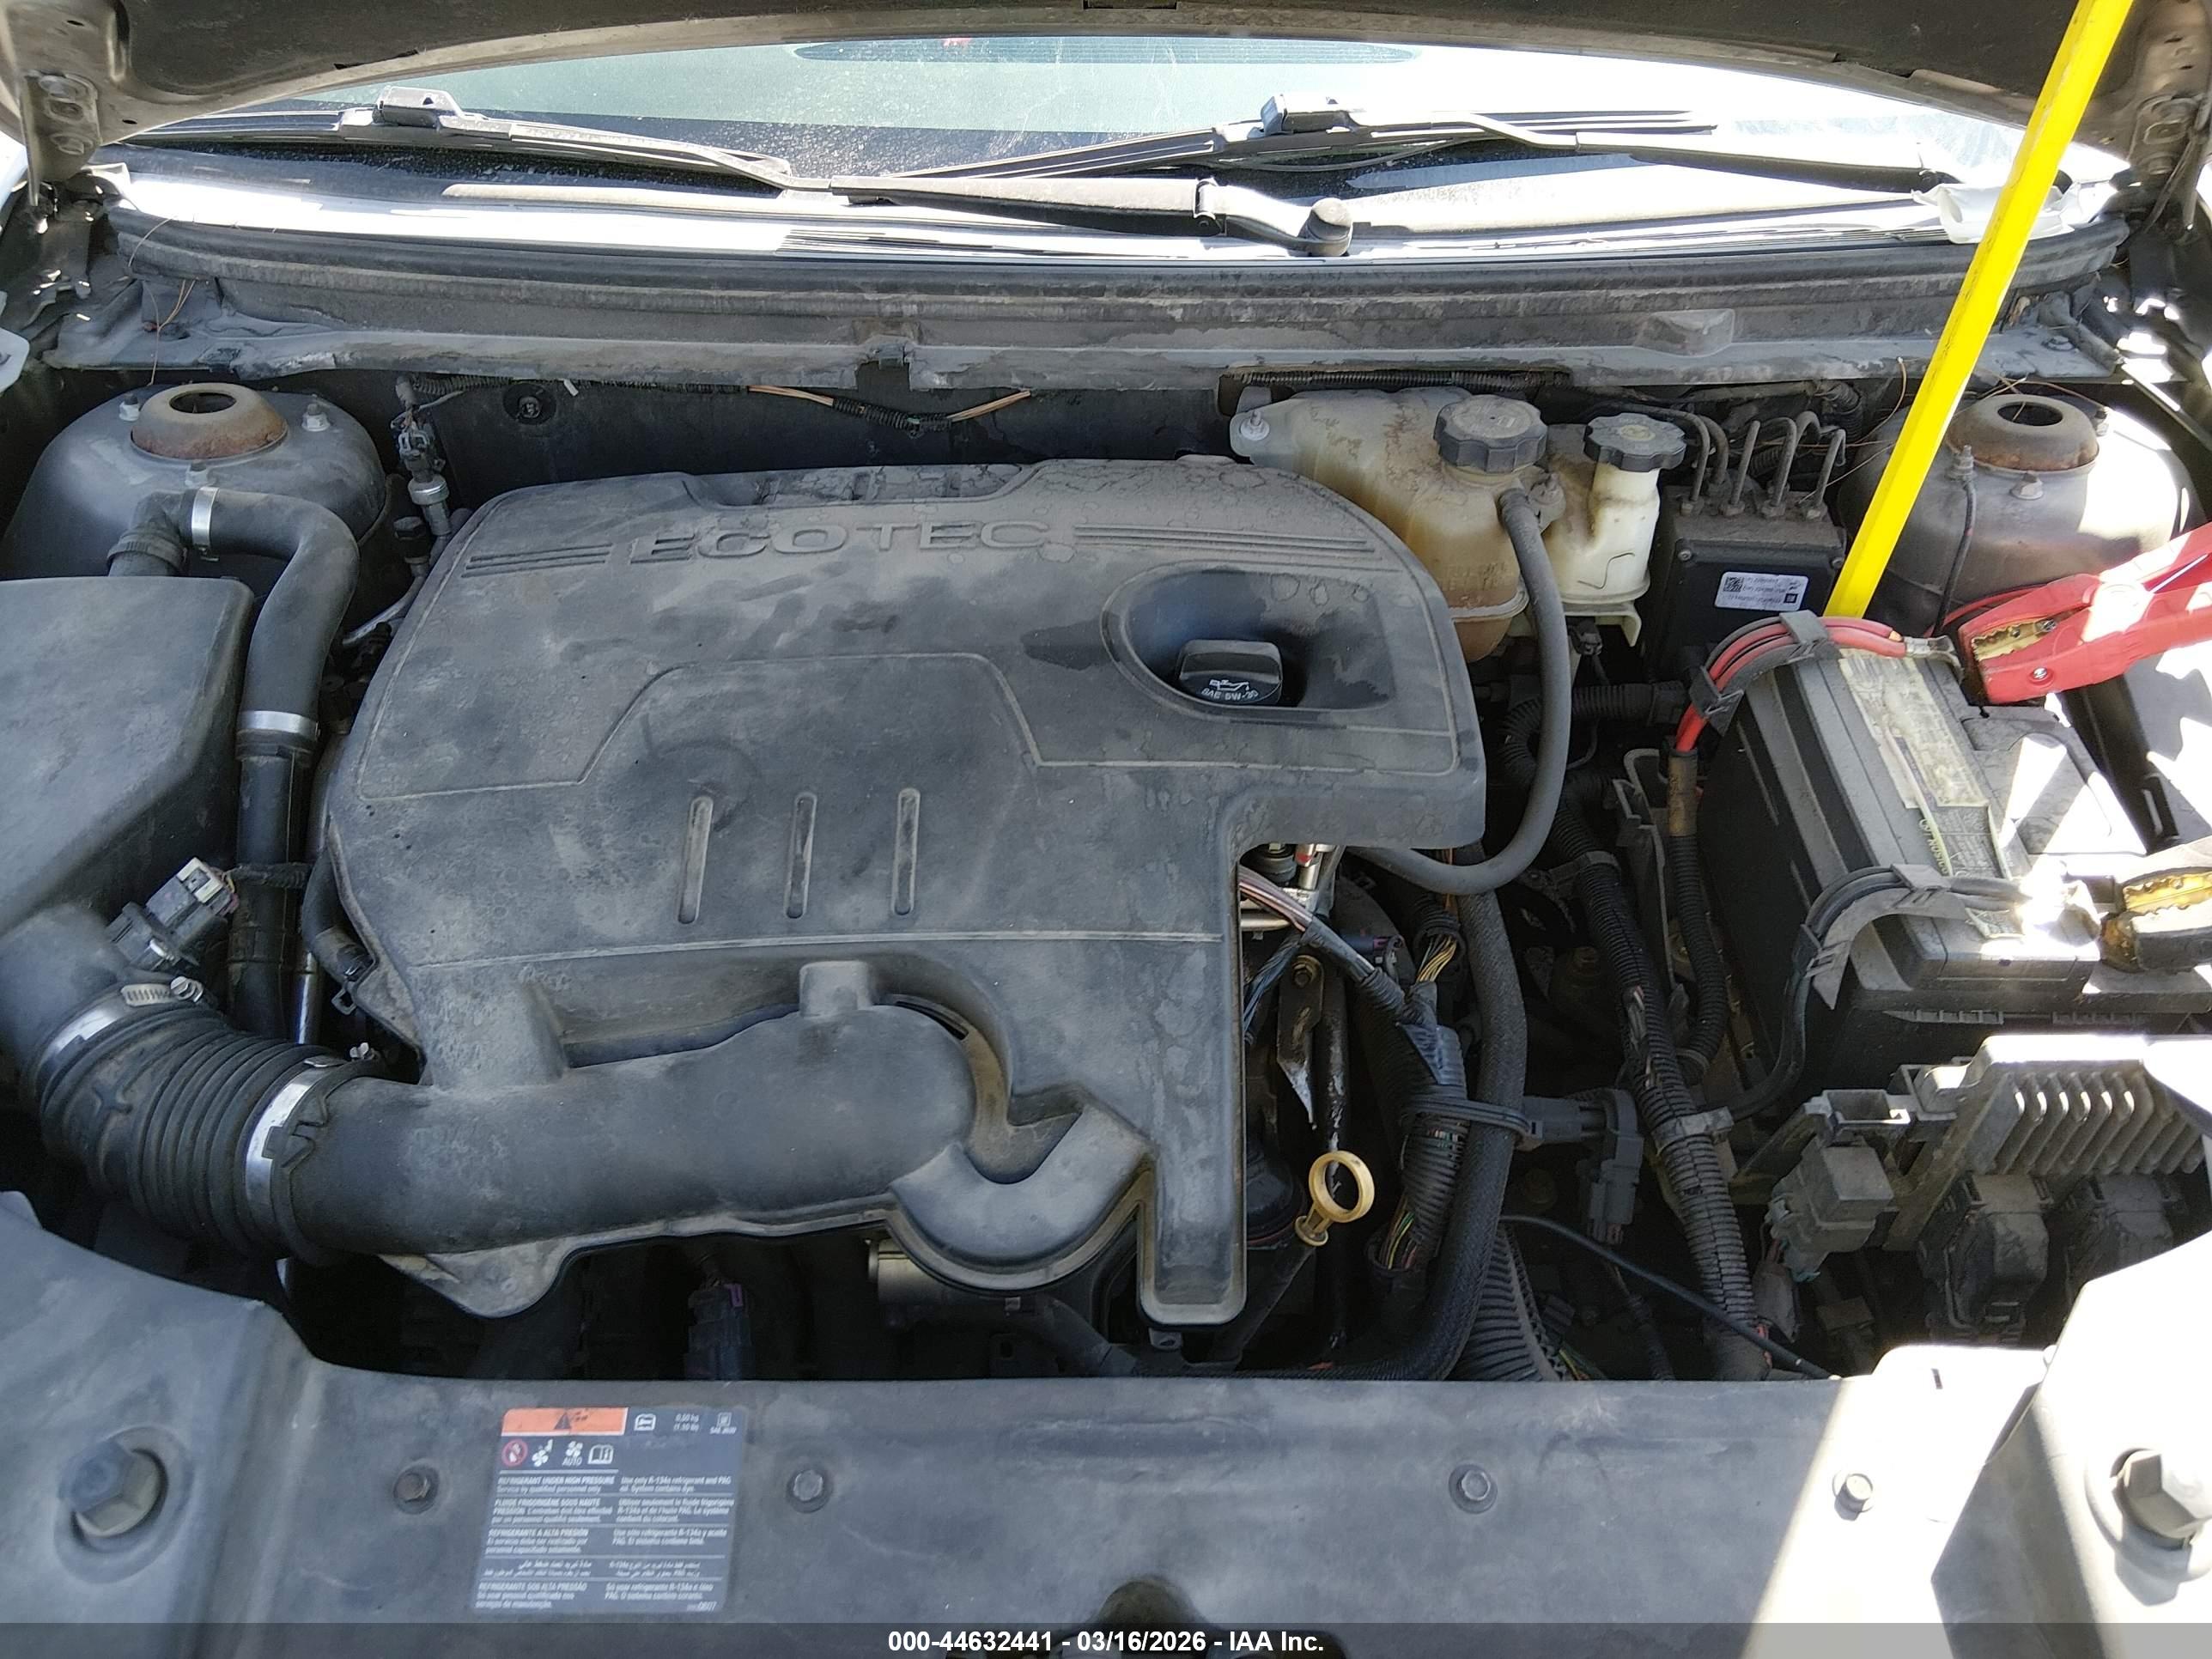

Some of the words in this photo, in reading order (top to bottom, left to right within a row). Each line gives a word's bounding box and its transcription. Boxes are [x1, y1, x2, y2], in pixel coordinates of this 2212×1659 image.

[629, 521, 1050, 564] ECOTEC
[562, 1456, 582, 1466] AUTO
[498, 1476, 543, 1485] REFRIGERANT
[541, 1476, 566, 1485] UNDER
[564, 1476, 582, 1485] HIGH
[580, 1476, 615, 1485] PRESSURE
[672, 1476, 705, 1485] refrigerant
[704, 1476, 718, 1485] and
